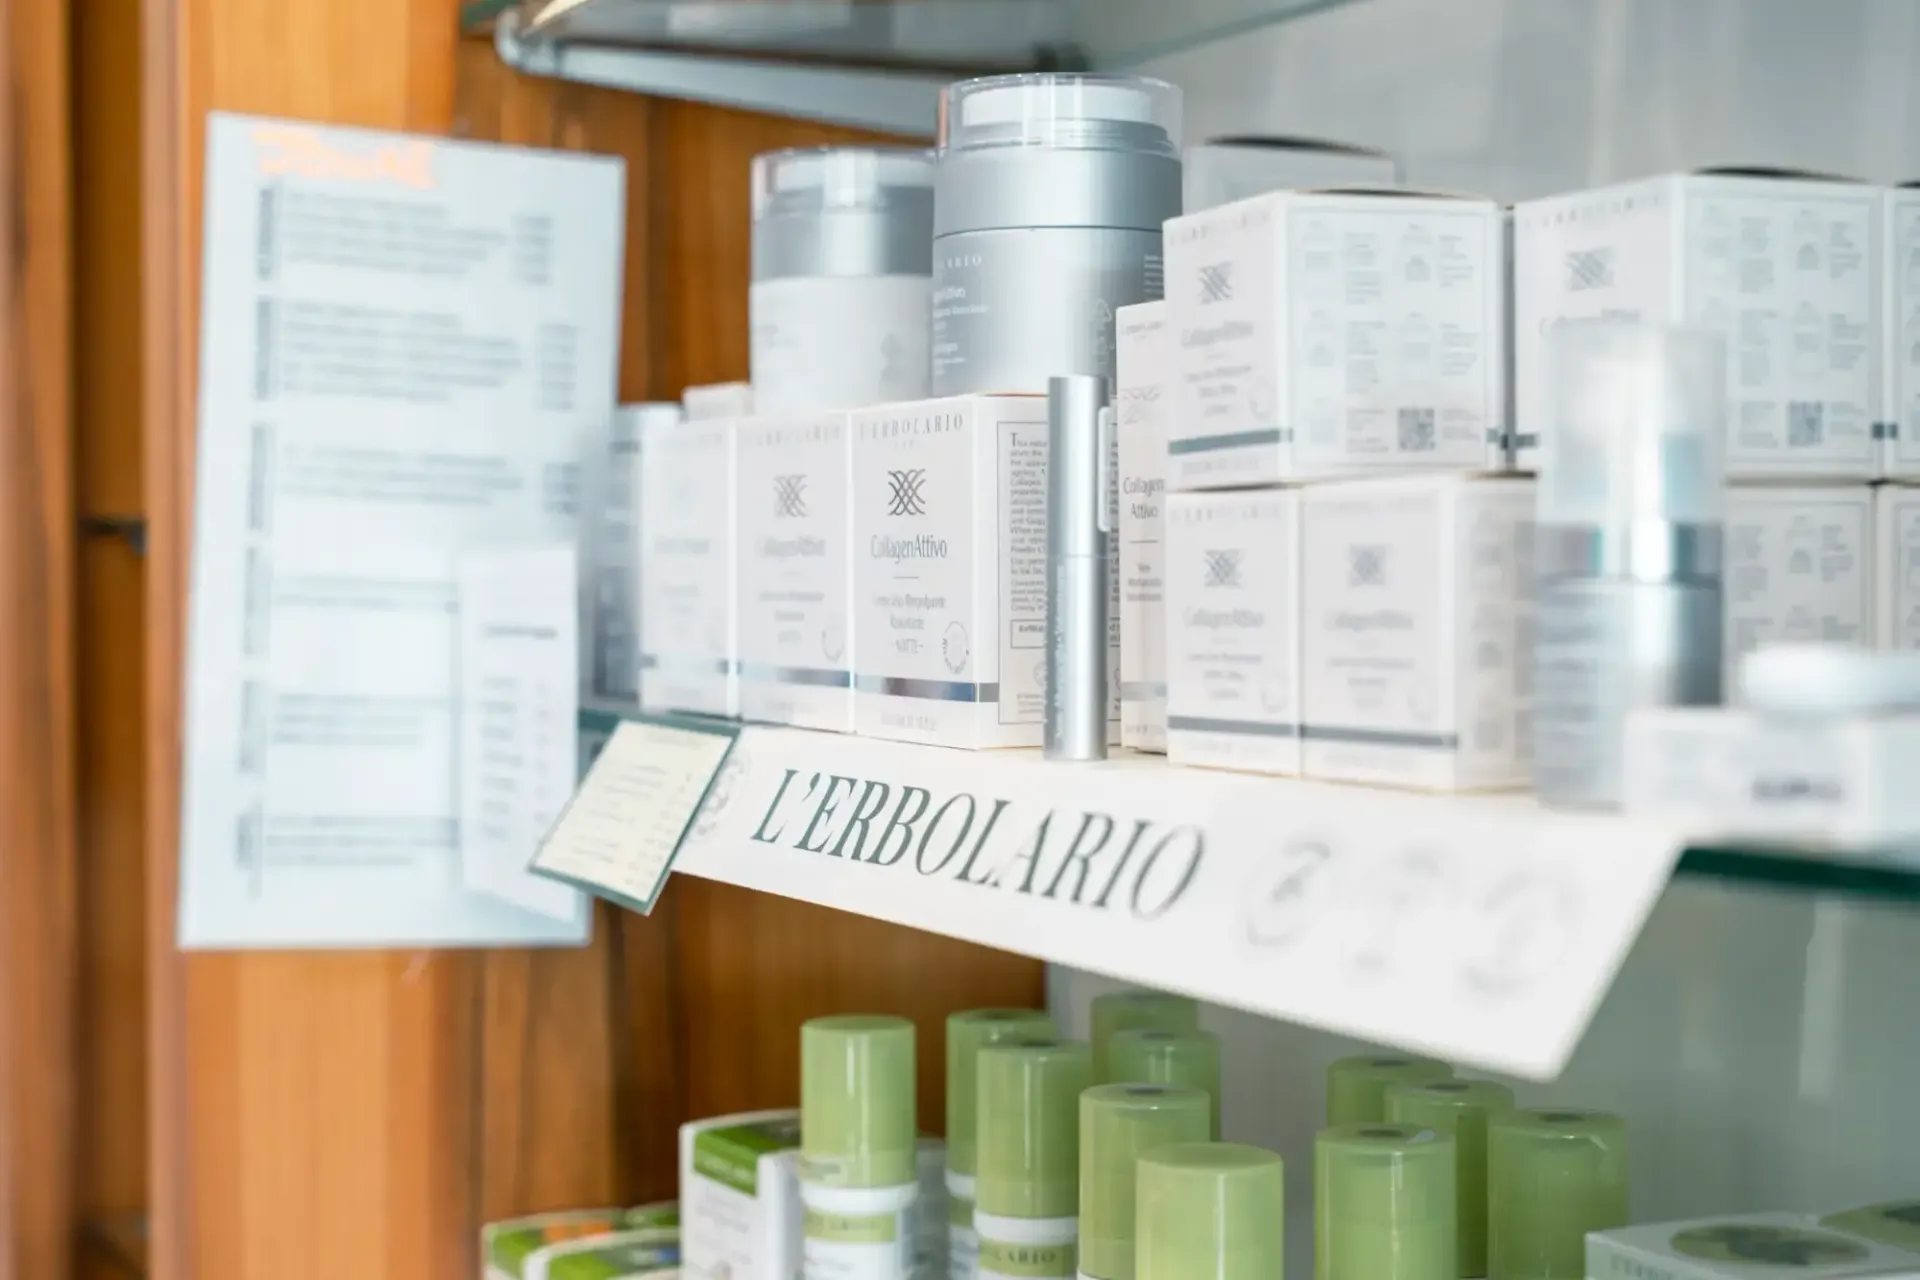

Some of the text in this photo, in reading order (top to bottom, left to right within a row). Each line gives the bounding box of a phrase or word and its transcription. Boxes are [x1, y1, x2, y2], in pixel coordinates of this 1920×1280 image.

[1122, 477, 1164, 498] Collagen
[1130, 502, 1159, 520] Attivo
[870, 533, 948, 564] CollagenAttivo
[750, 768, 1208, 922] L'ERBOLARIO
